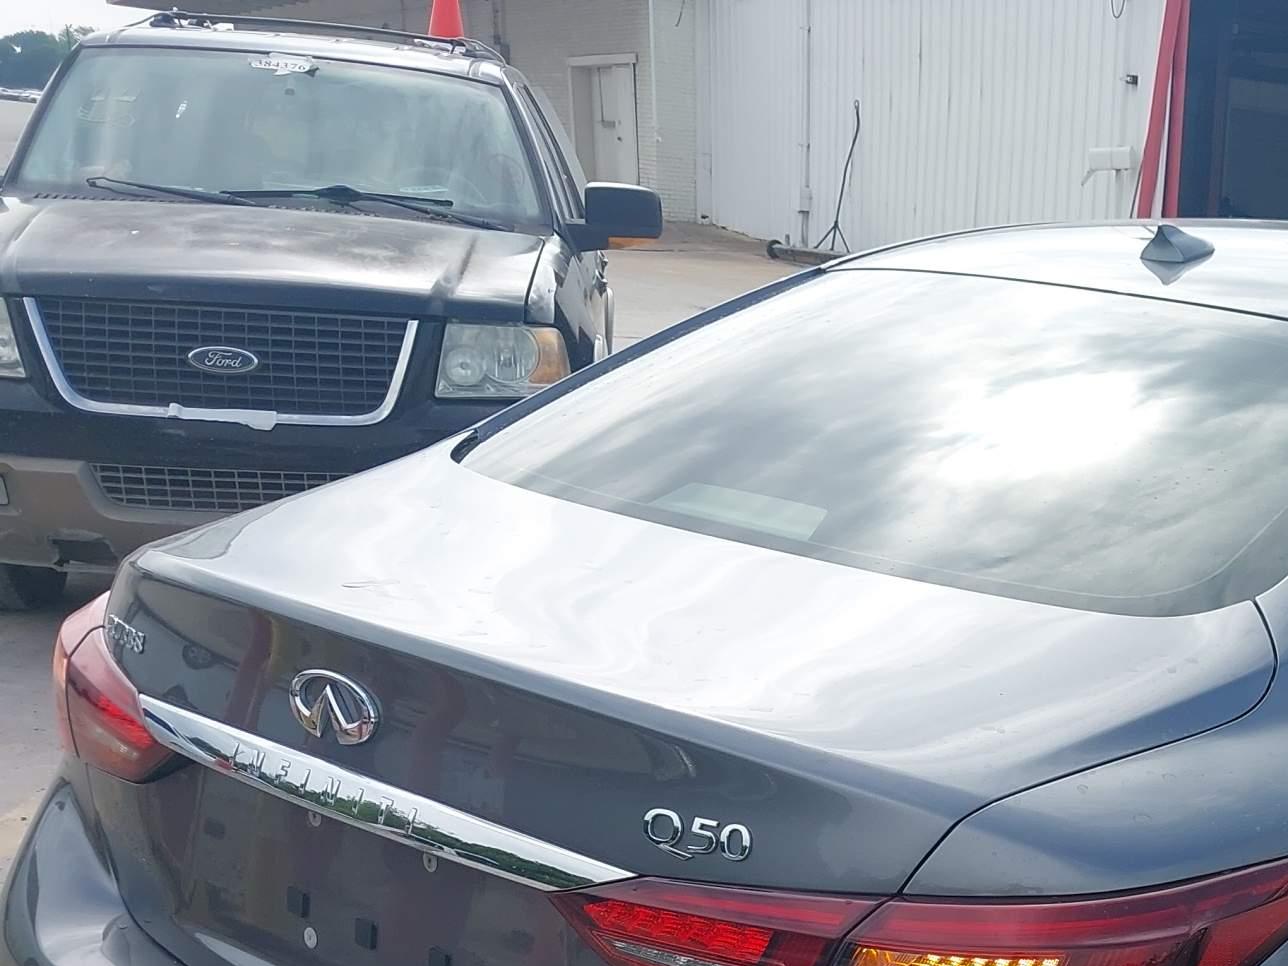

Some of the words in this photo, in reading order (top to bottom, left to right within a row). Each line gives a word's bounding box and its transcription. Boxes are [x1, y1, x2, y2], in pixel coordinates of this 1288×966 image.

[204, 351, 242, 368] Ford
[228, 742, 418, 836] INFINITI
[643, 807, 752, 861] Q50
